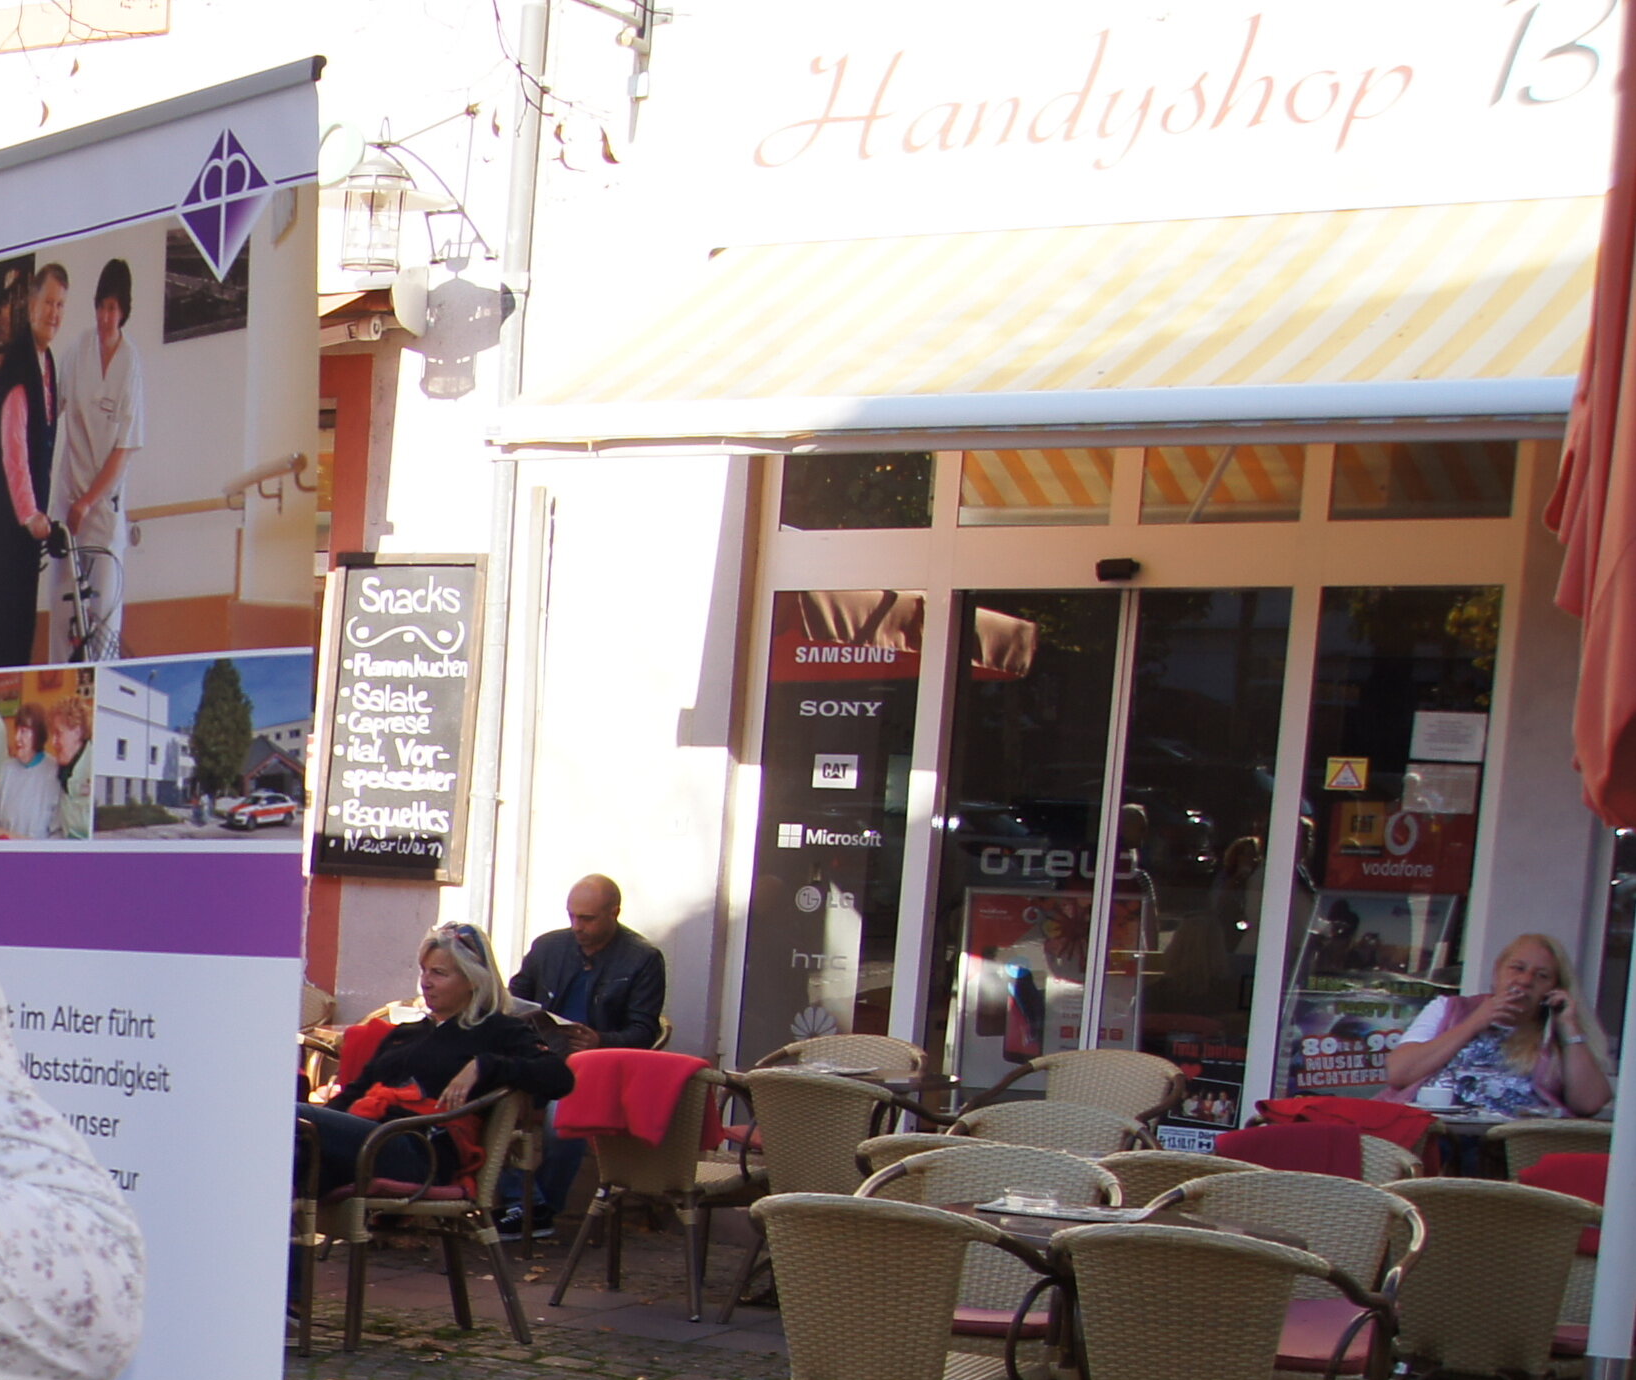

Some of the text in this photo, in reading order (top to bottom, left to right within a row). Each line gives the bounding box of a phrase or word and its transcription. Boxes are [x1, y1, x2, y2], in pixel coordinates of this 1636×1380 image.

[752, 13, 1413, 169] Handyshop
[359, 576, 460, 614] Snacks
[795, 647, 895, 663] SAMSUNG
[352, 682, 432, 713] Salate
[800, 701, 882, 716] SONY
[347, 735, 450, 768] ital. Vor-
[823, 763, 849, 779] CAT
[343, 799, 449, 839] Baguettes
[344, 829, 442, 858] Neuer Wein
[806, 829, 881, 847] Microsoft
[1362, 860, 1434, 877] vodafone
[826, 892, 854, 908] LG
[20, 1003, 44, 1030] im
[52, 1006, 102, 1034] Alter
[108, 1009, 156, 1039] führt
[1305, 1055, 1364, 1071] MUSIK
